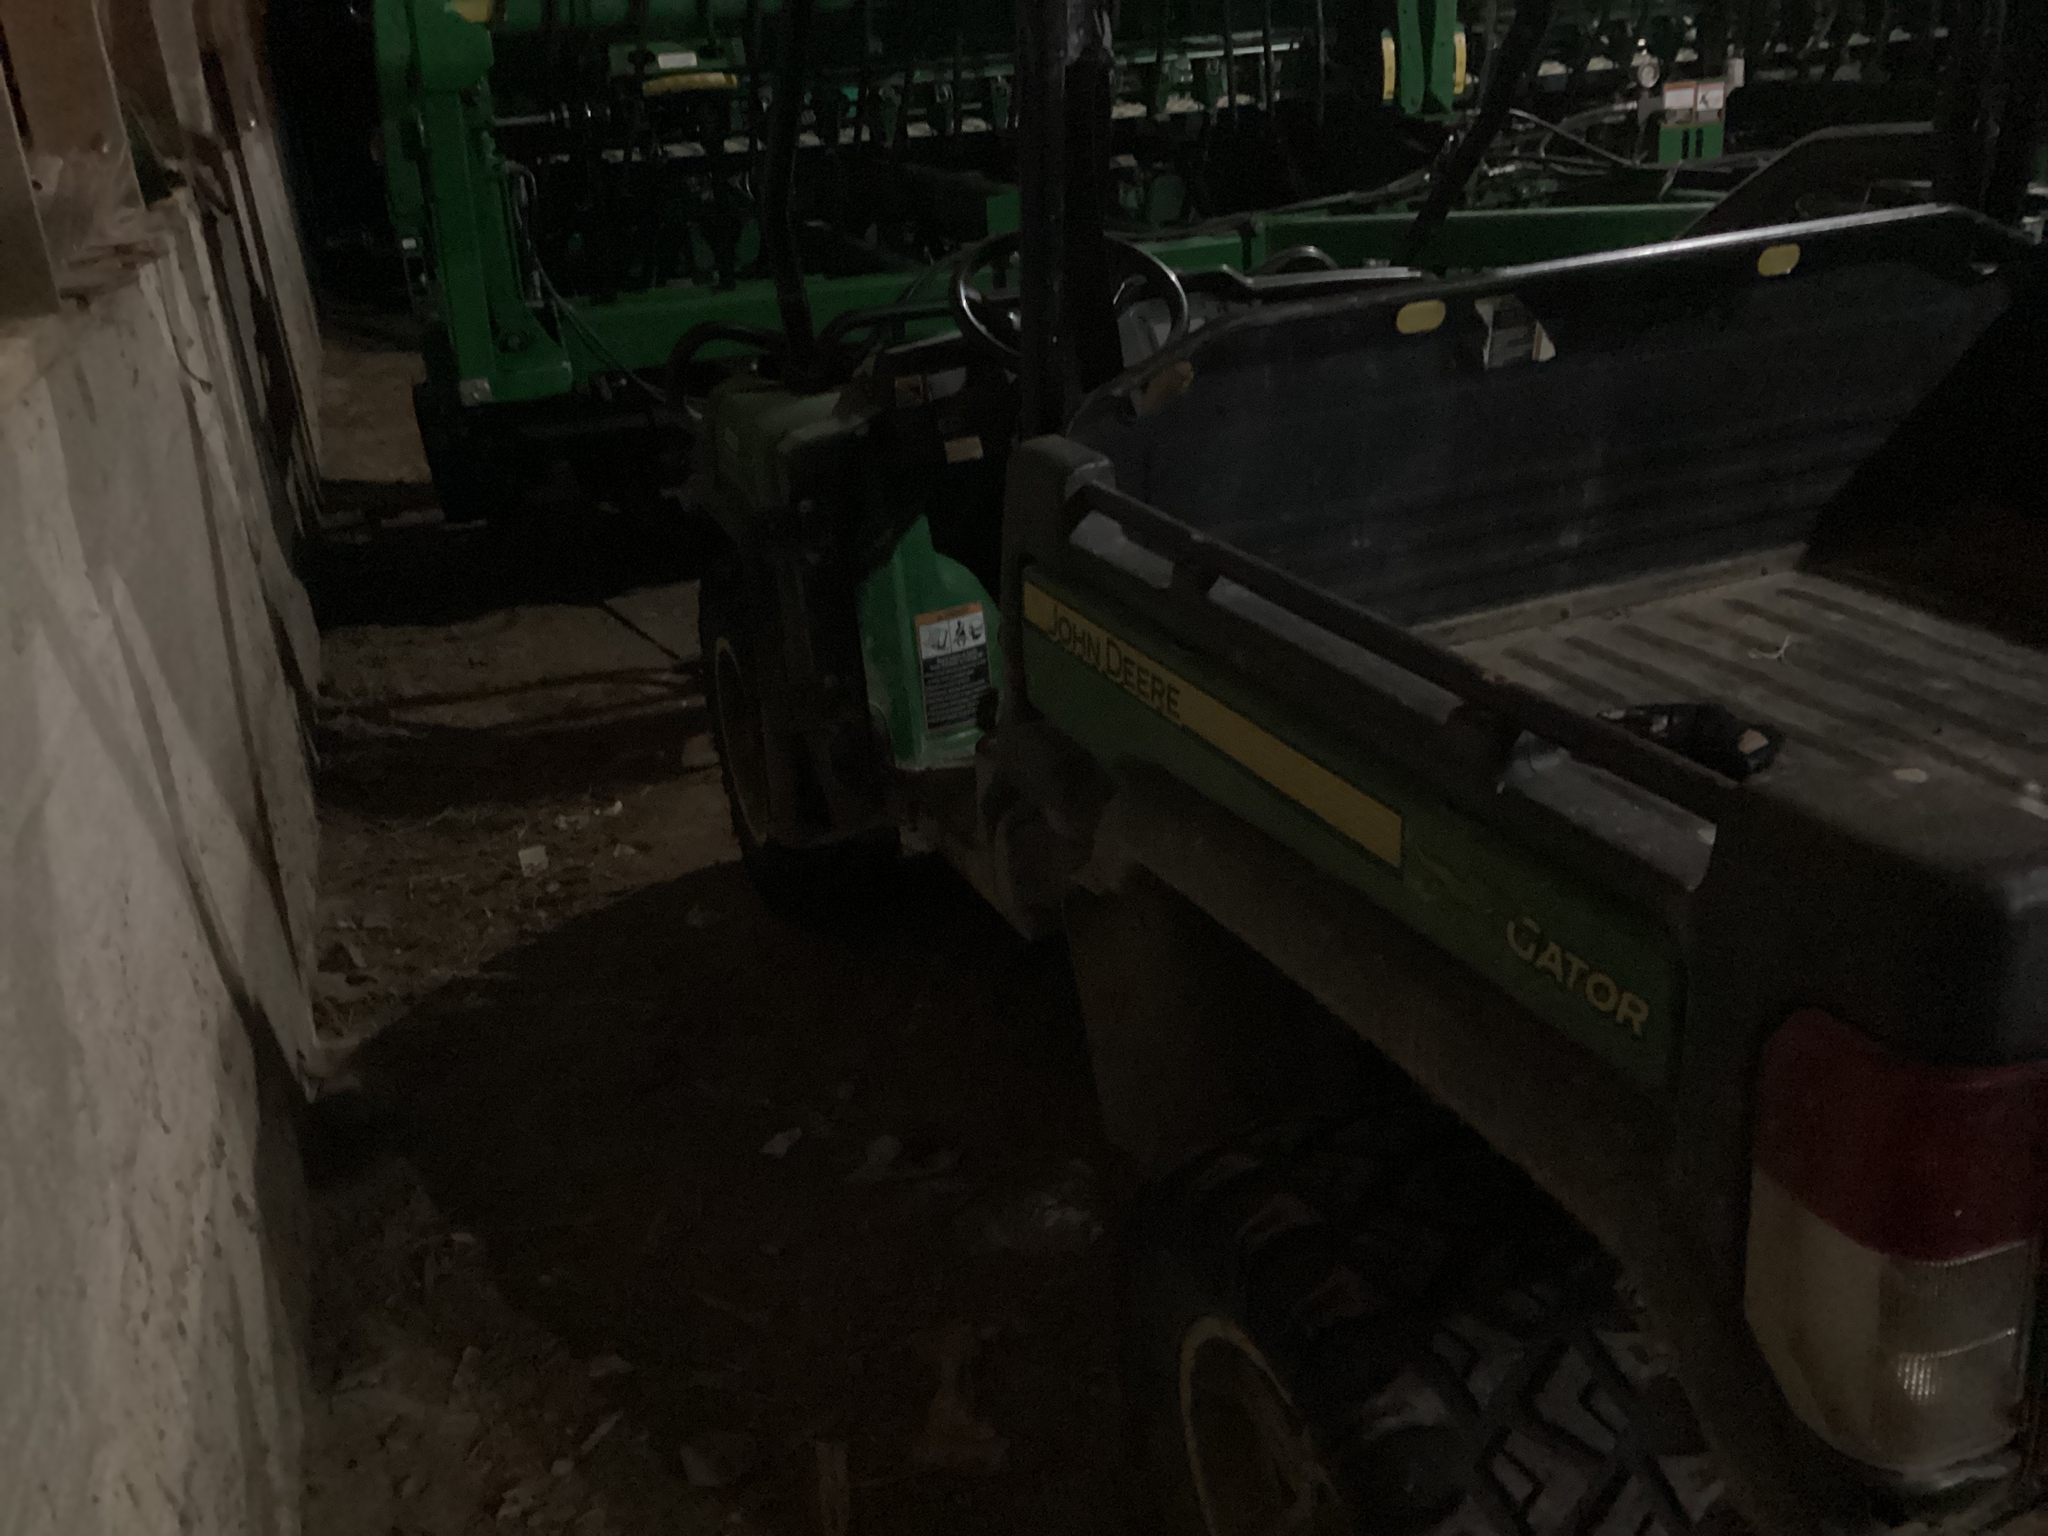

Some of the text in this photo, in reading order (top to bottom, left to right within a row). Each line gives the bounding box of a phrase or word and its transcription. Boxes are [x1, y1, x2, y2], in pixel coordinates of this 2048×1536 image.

[1050, 603, 1181, 719] JOHN DEERE
[1505, 915, 1649, 1037] GATOR
